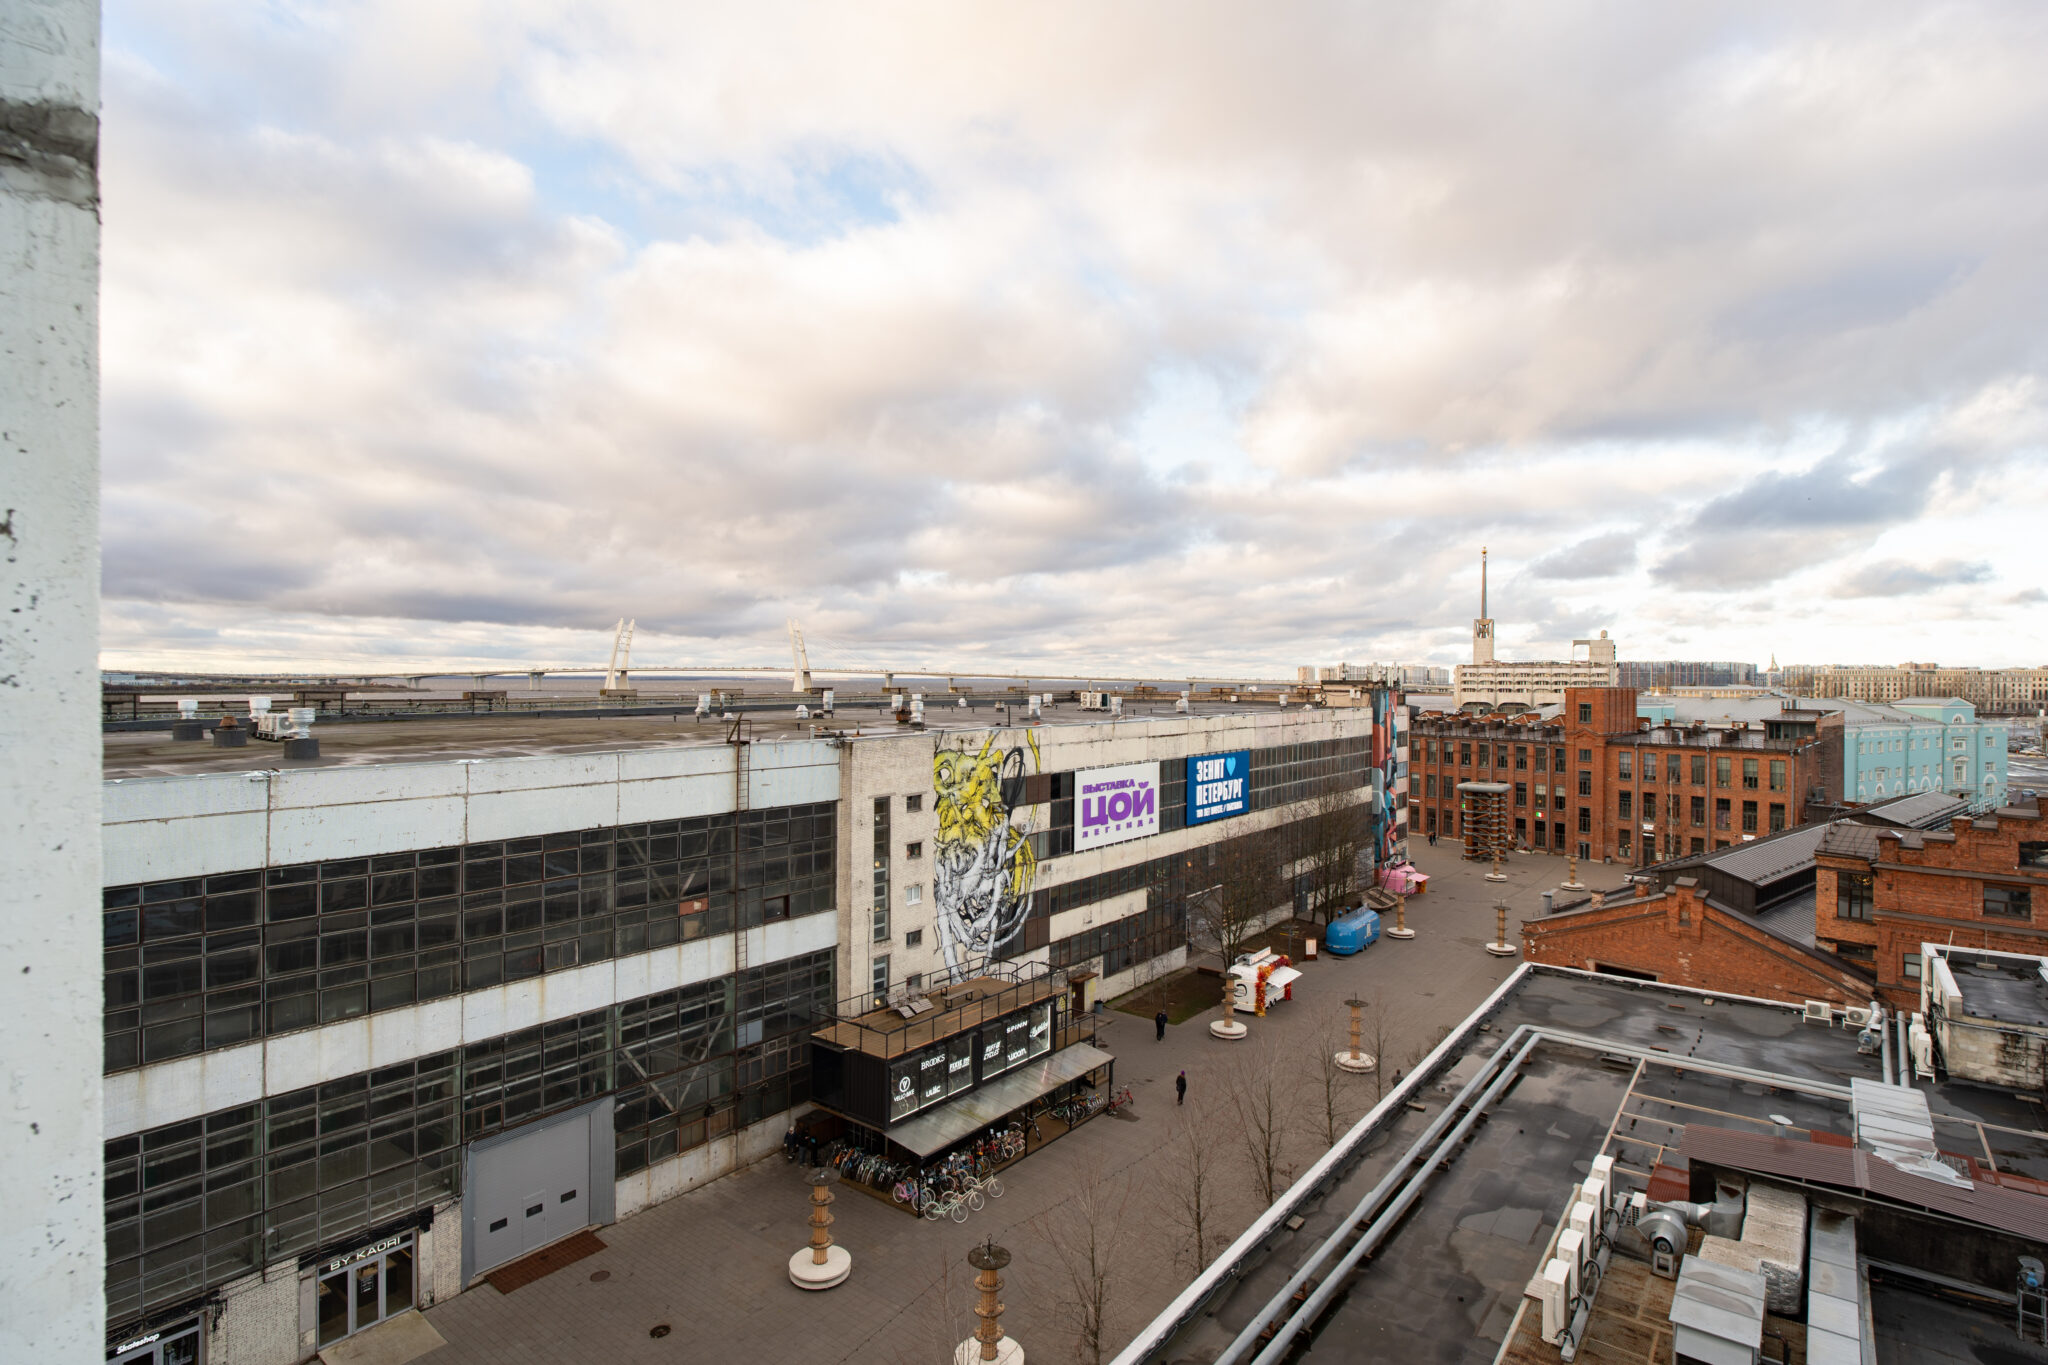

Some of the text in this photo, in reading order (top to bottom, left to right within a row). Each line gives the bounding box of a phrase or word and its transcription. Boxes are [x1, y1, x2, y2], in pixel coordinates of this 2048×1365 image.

[1196, 758, 1225, 783] ЗЕНИТ
[1082, 778, 1136, 794] ВЫСТАВКА
[1195, 778, 1243, 806] ПЕТЕРБУРГ
[1082, 781, 1155, 828] ЦОЙ
[1082, 817, 1155, 839] ЛЕГЕНДА
[921, 1053, 945, 1071] BROOKS
[329, 1236, 401, 1272] BY KAORI
[116, 1332, 160, 1355] Skateshop
